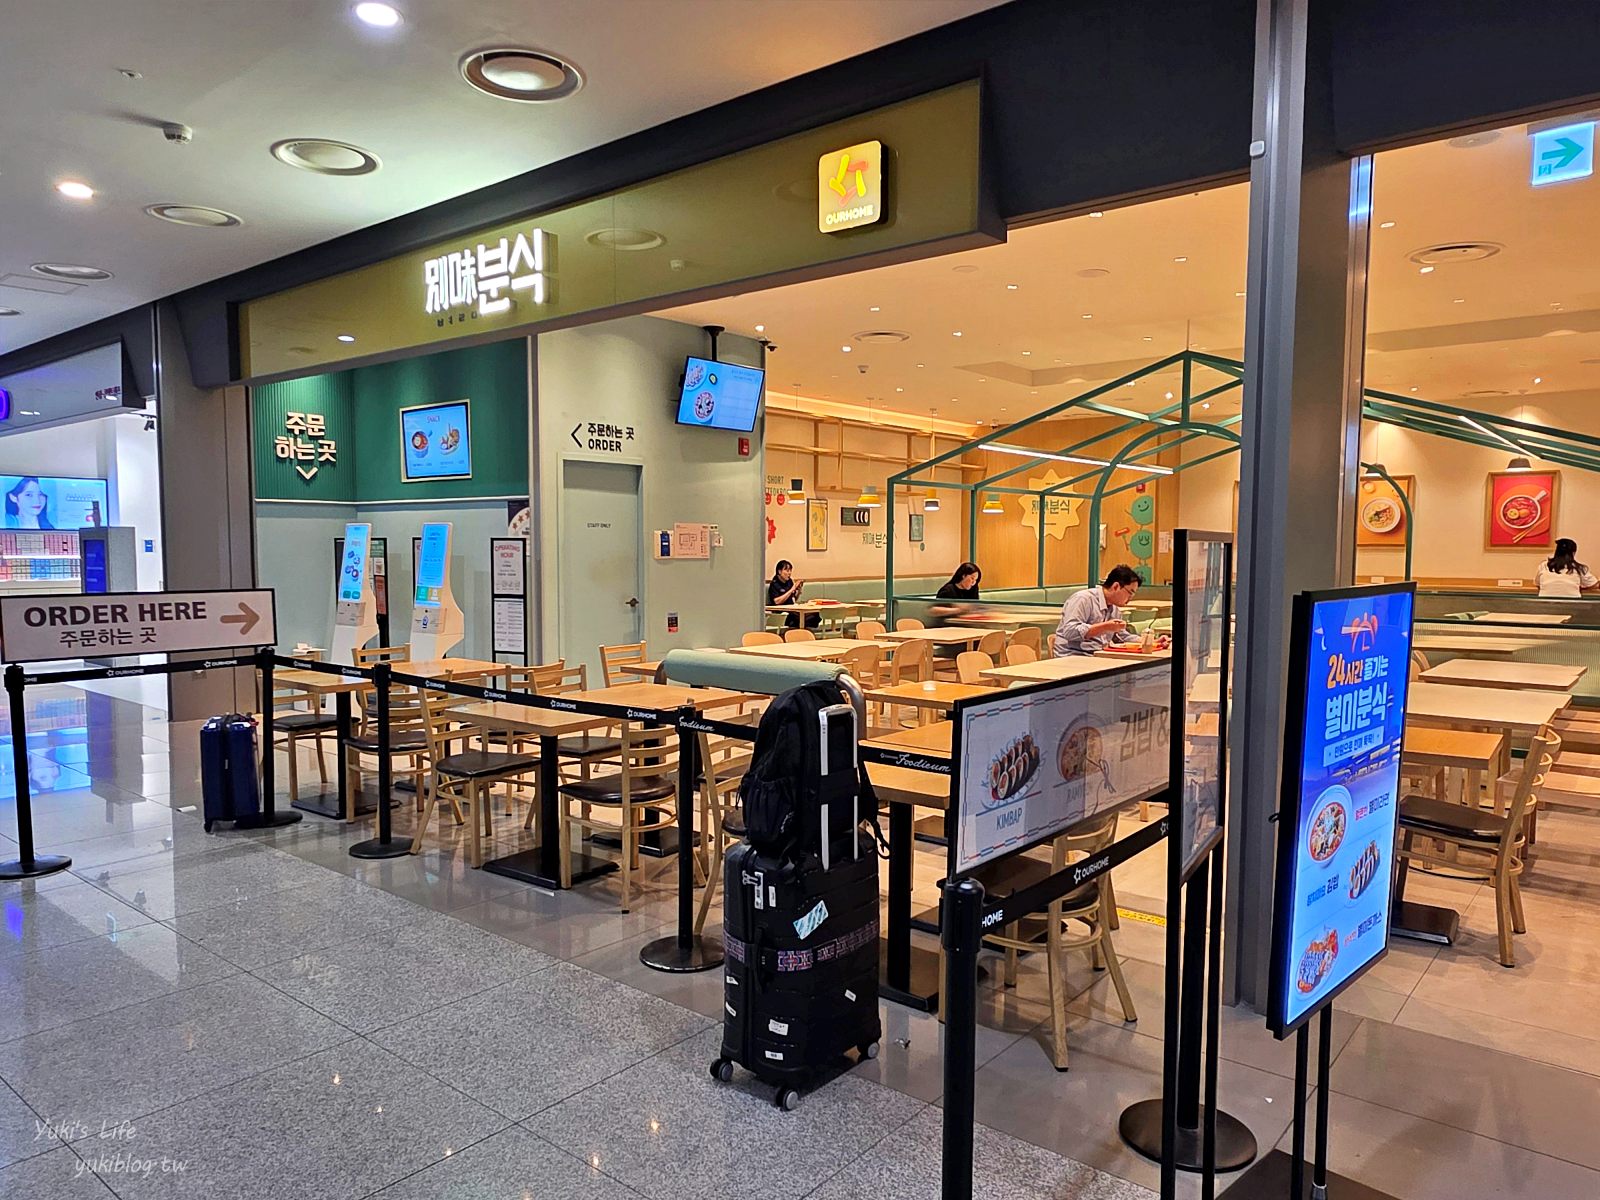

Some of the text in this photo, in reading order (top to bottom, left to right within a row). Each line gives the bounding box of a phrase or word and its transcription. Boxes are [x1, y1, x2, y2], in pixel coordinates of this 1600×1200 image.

[825, 204, 873, 225] OURHOME
[424, 228, 544, 315] 別味분식
[285, 411, 326, 436] 주문
[587, 422, 635, 441] 주문하는 곳
[274, 435, 337, 463] 하는 곳
[588, 438, 622, 453] ORDER
[24, 601, 207, 628] ORDER HERE
[60, 626, 157, 648] 주문하는 곳
[1327, 653, 1389, 689] 24시간 즐기는
[633, 711, 657, 720] OURHOME
[1325, 681, 1388, 741] 별미분식
[1120, 708, 1154, 763] 김밥
[996, 807, 1023, 831] KIMBAP
[1081, 856, 1110, 879] OURHOME
